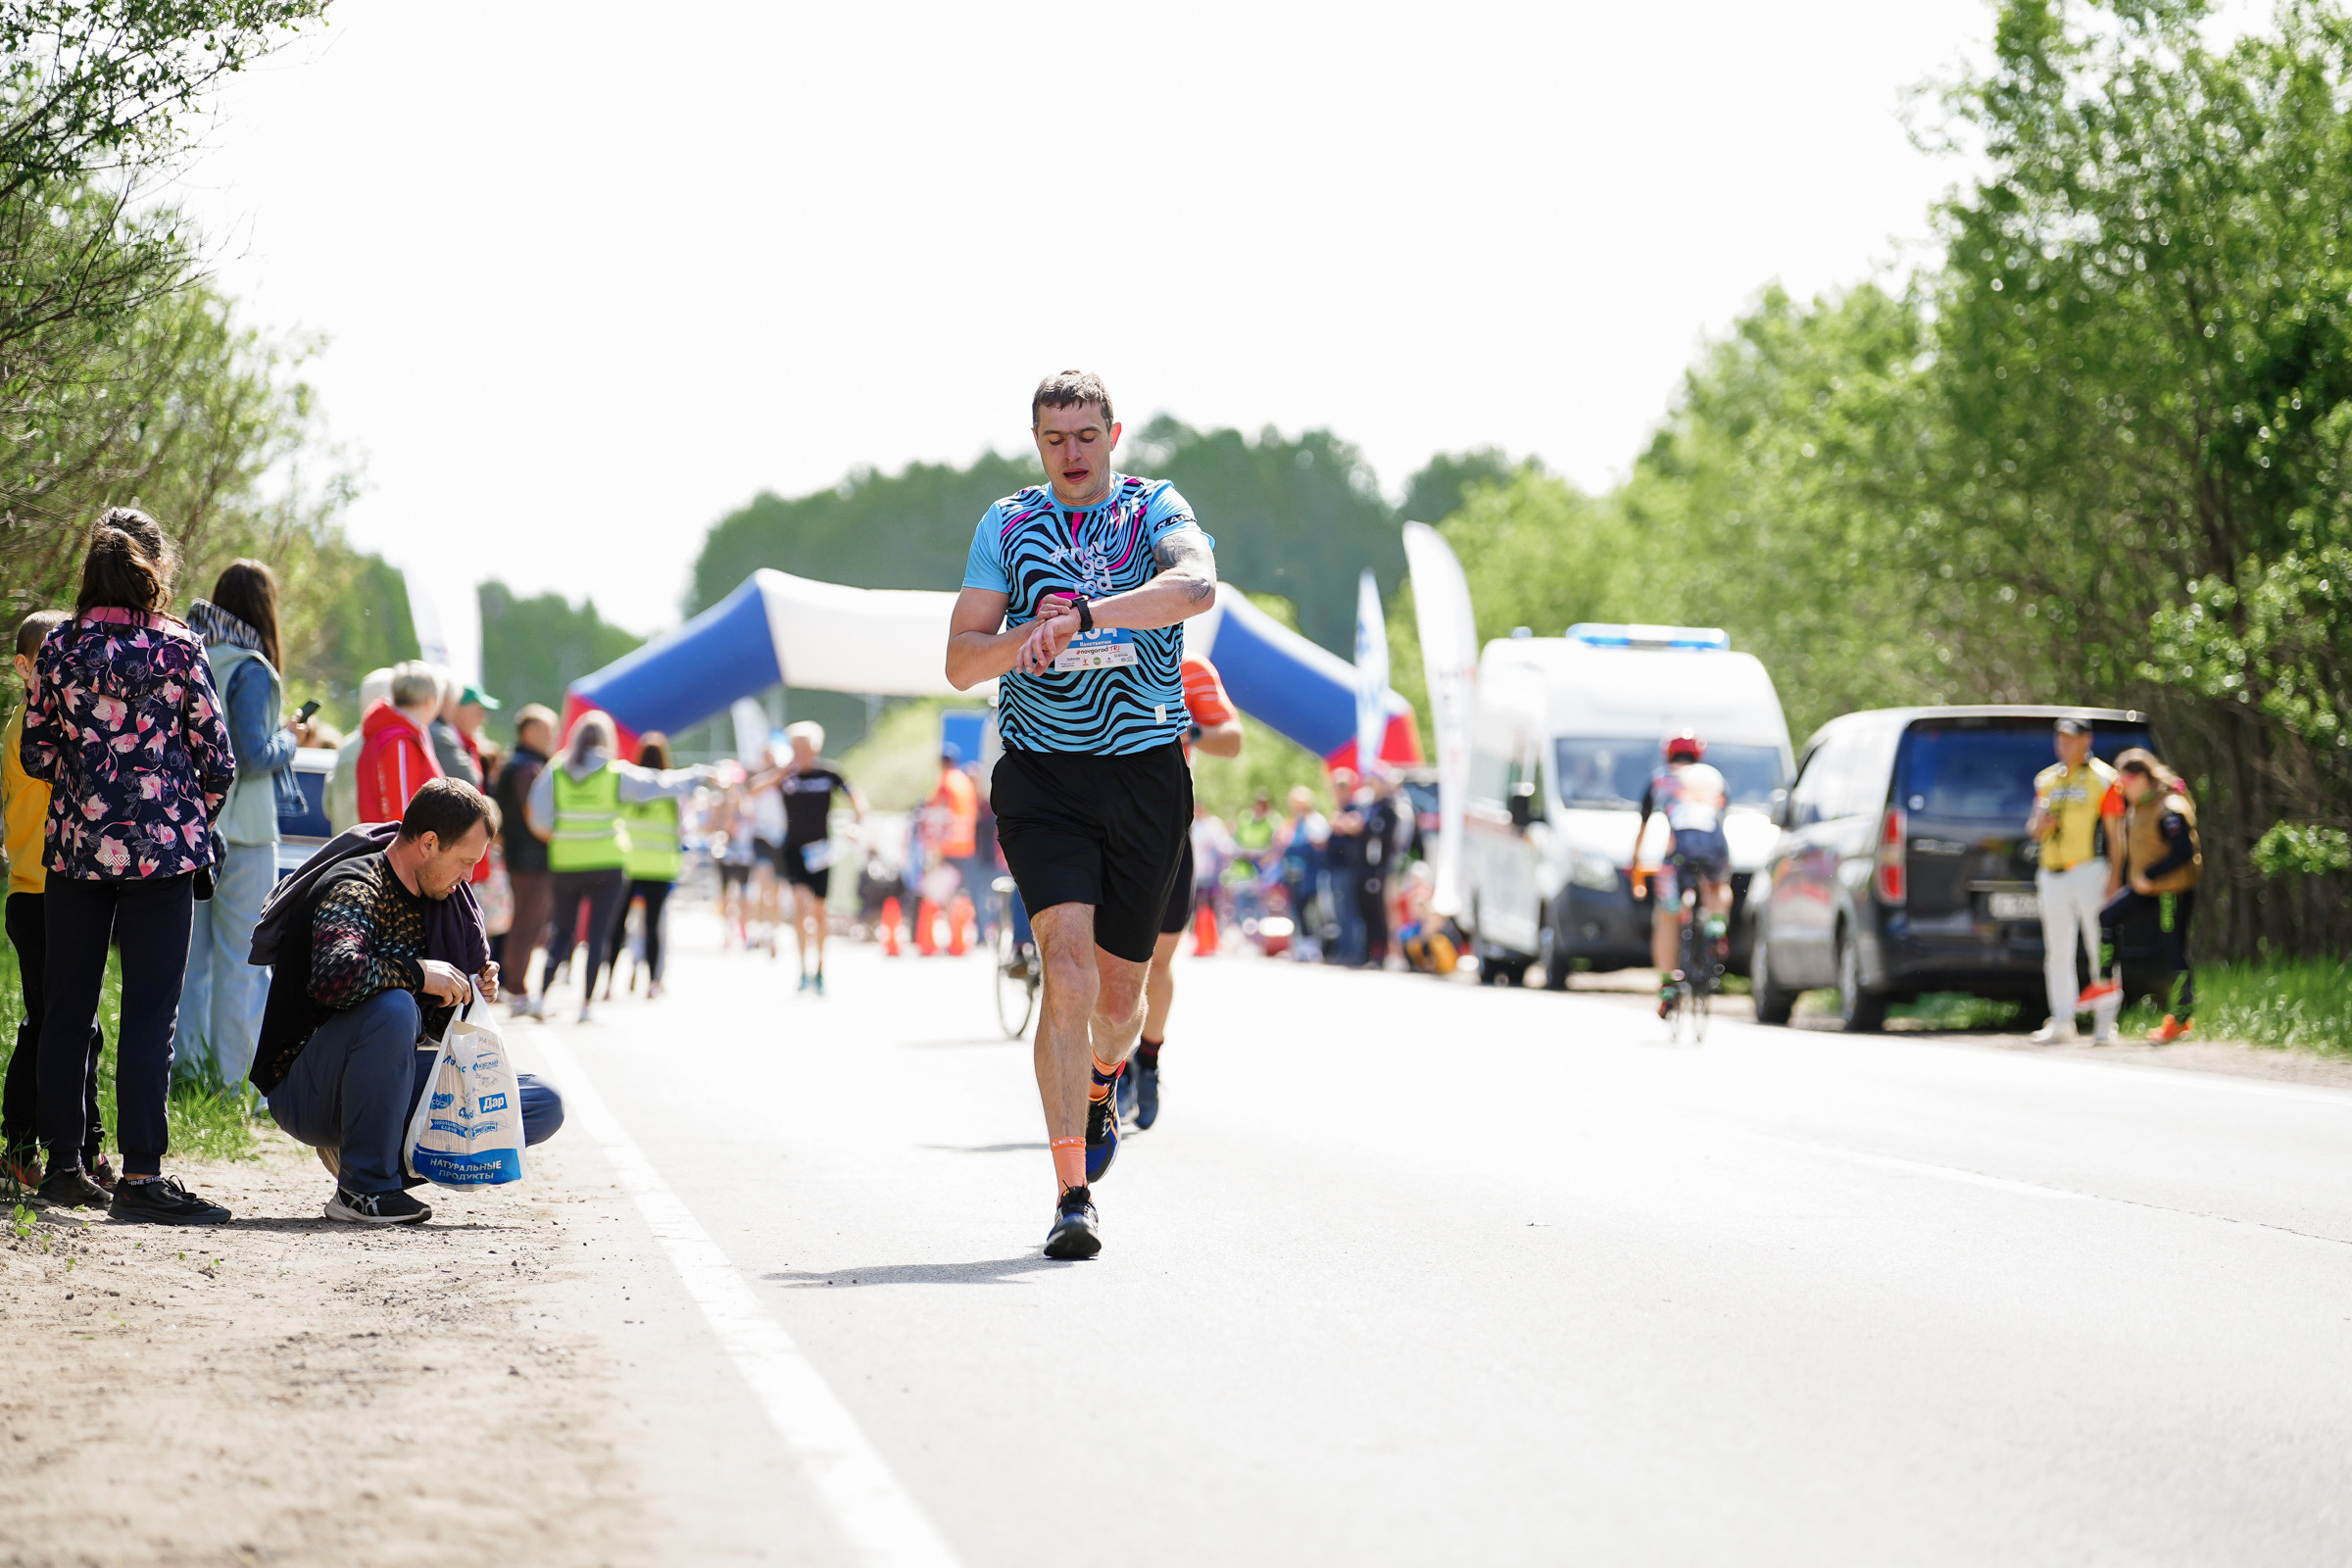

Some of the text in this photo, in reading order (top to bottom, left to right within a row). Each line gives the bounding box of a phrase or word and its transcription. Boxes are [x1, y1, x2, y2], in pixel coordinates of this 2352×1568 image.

[1049, 540, 1106, 564] #nov
[1082, 555, 1107, 580] go
[1073, 567, 1113, 595] rod
[1076, 646, 1109, 656] #novgorod
[482, 1096, 505, 1111] Дар
[429, 1157, 502, 1172] НАТУРАЛЬНЫЕ
[438, 1169, 494, 1181] ПРОДУКТЫ
